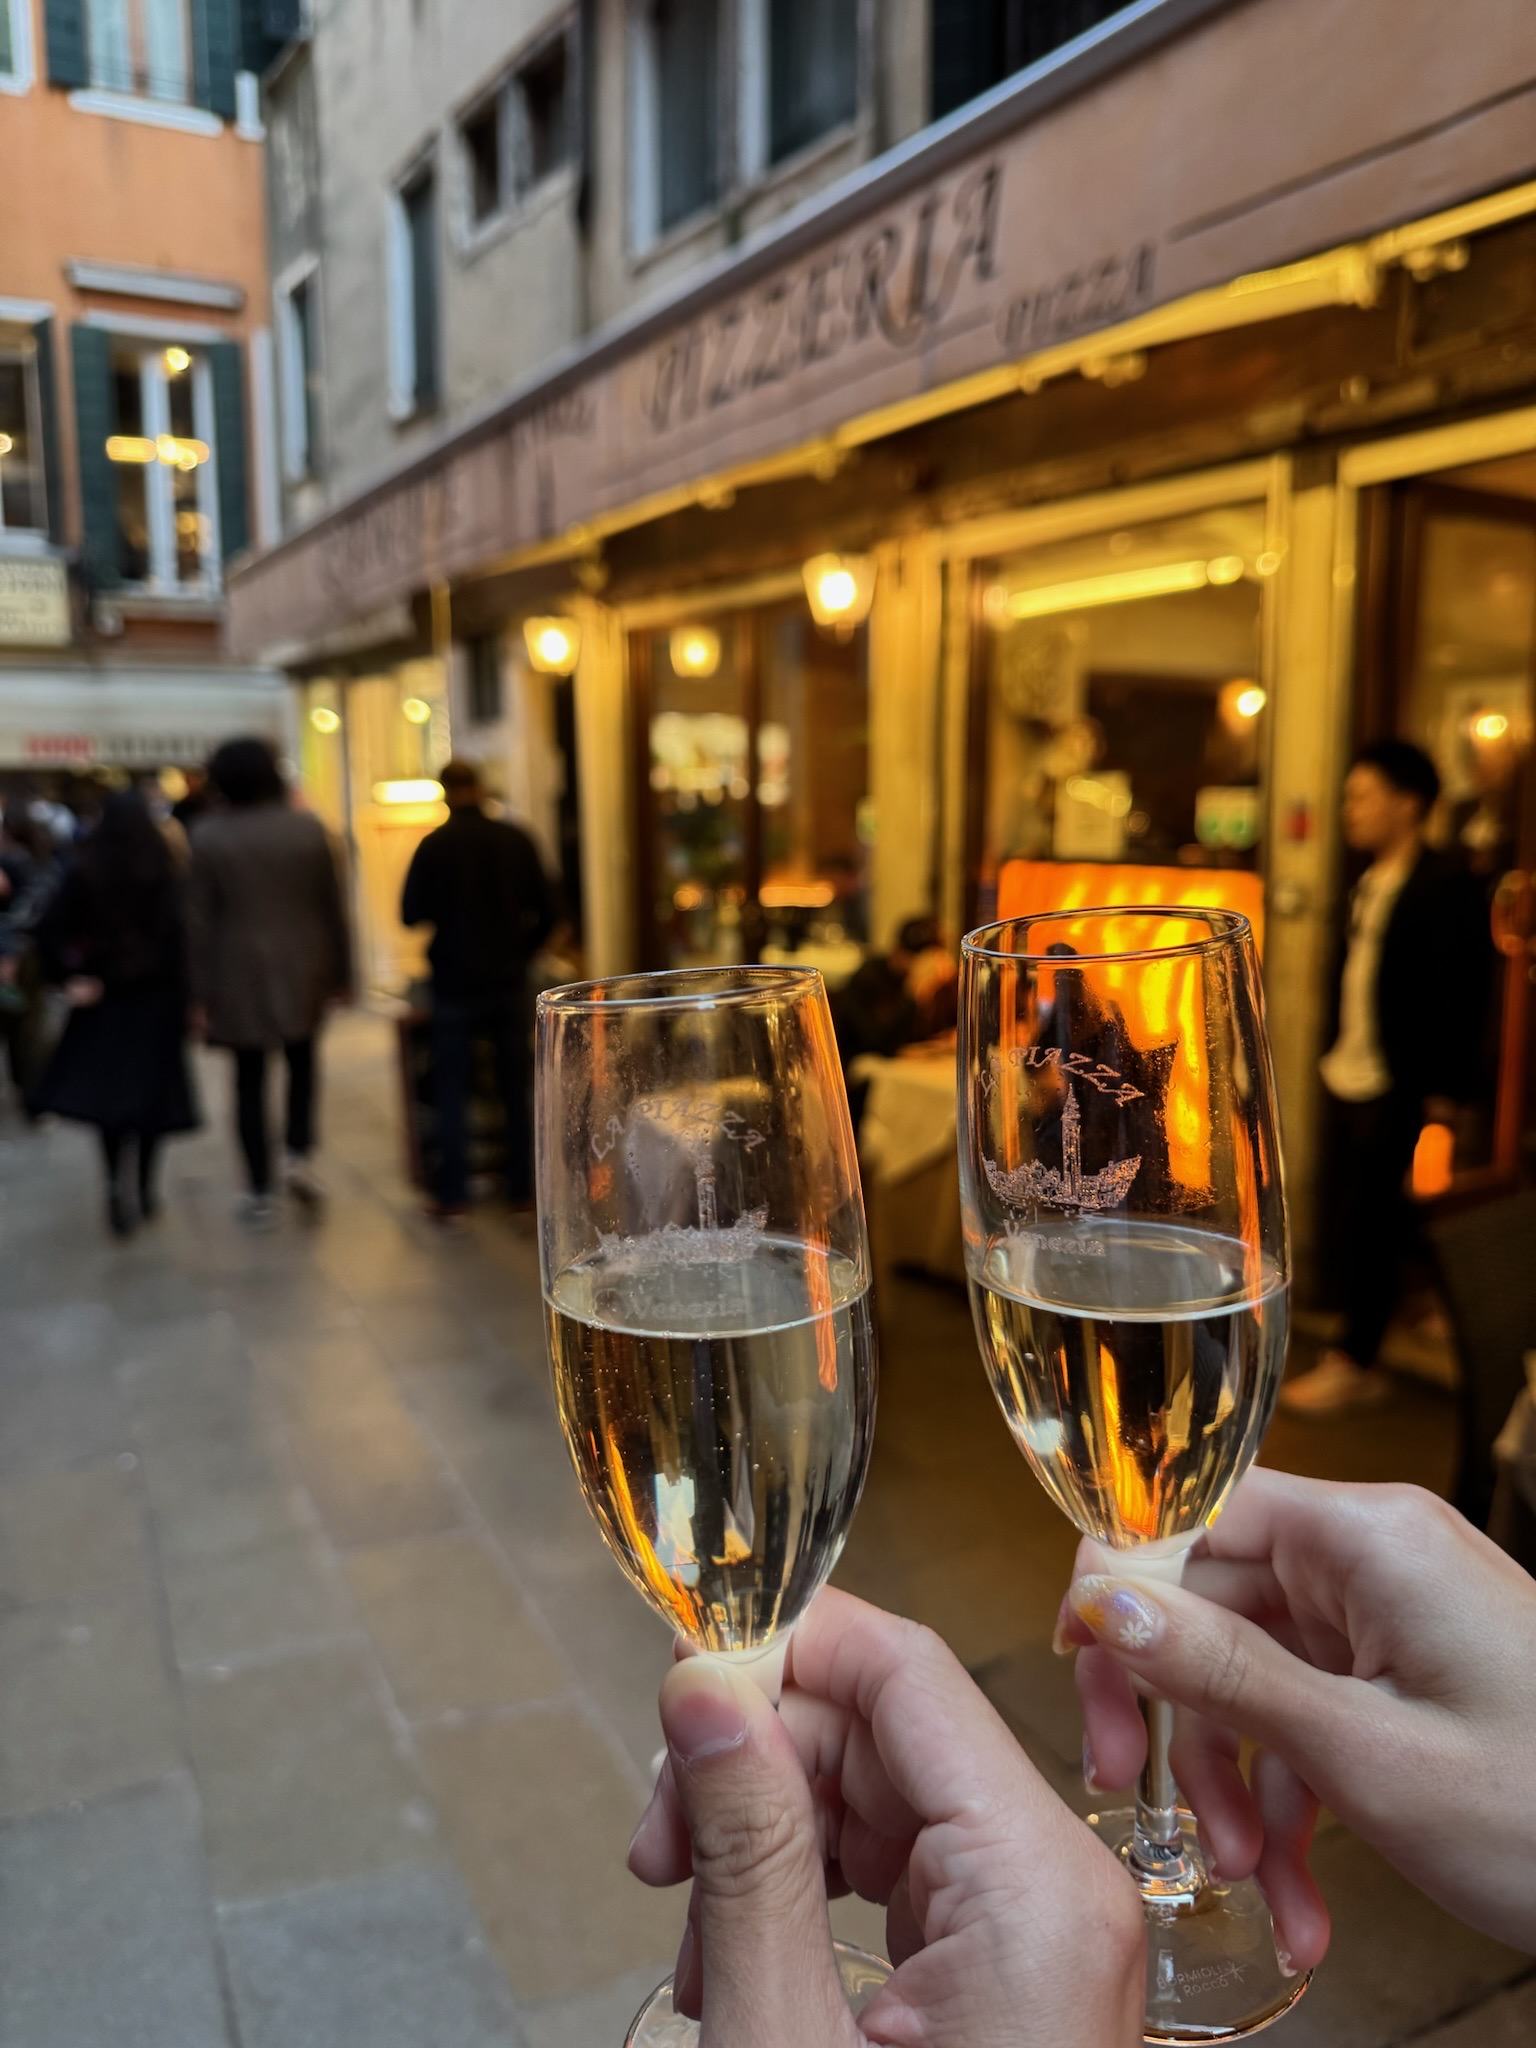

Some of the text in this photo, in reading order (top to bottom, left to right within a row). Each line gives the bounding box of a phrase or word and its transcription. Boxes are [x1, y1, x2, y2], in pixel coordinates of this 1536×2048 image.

[640, 163, 1001, 432] PIZZERIA
[1009, 1046, 1146, 1108] PIAZZA
[628, 1097, 766, 1153] PIAZZA
[1156, 1964, 1223, 1990] BORMIOLI
[1182, 1976, 1230, 1997] ROCCO
